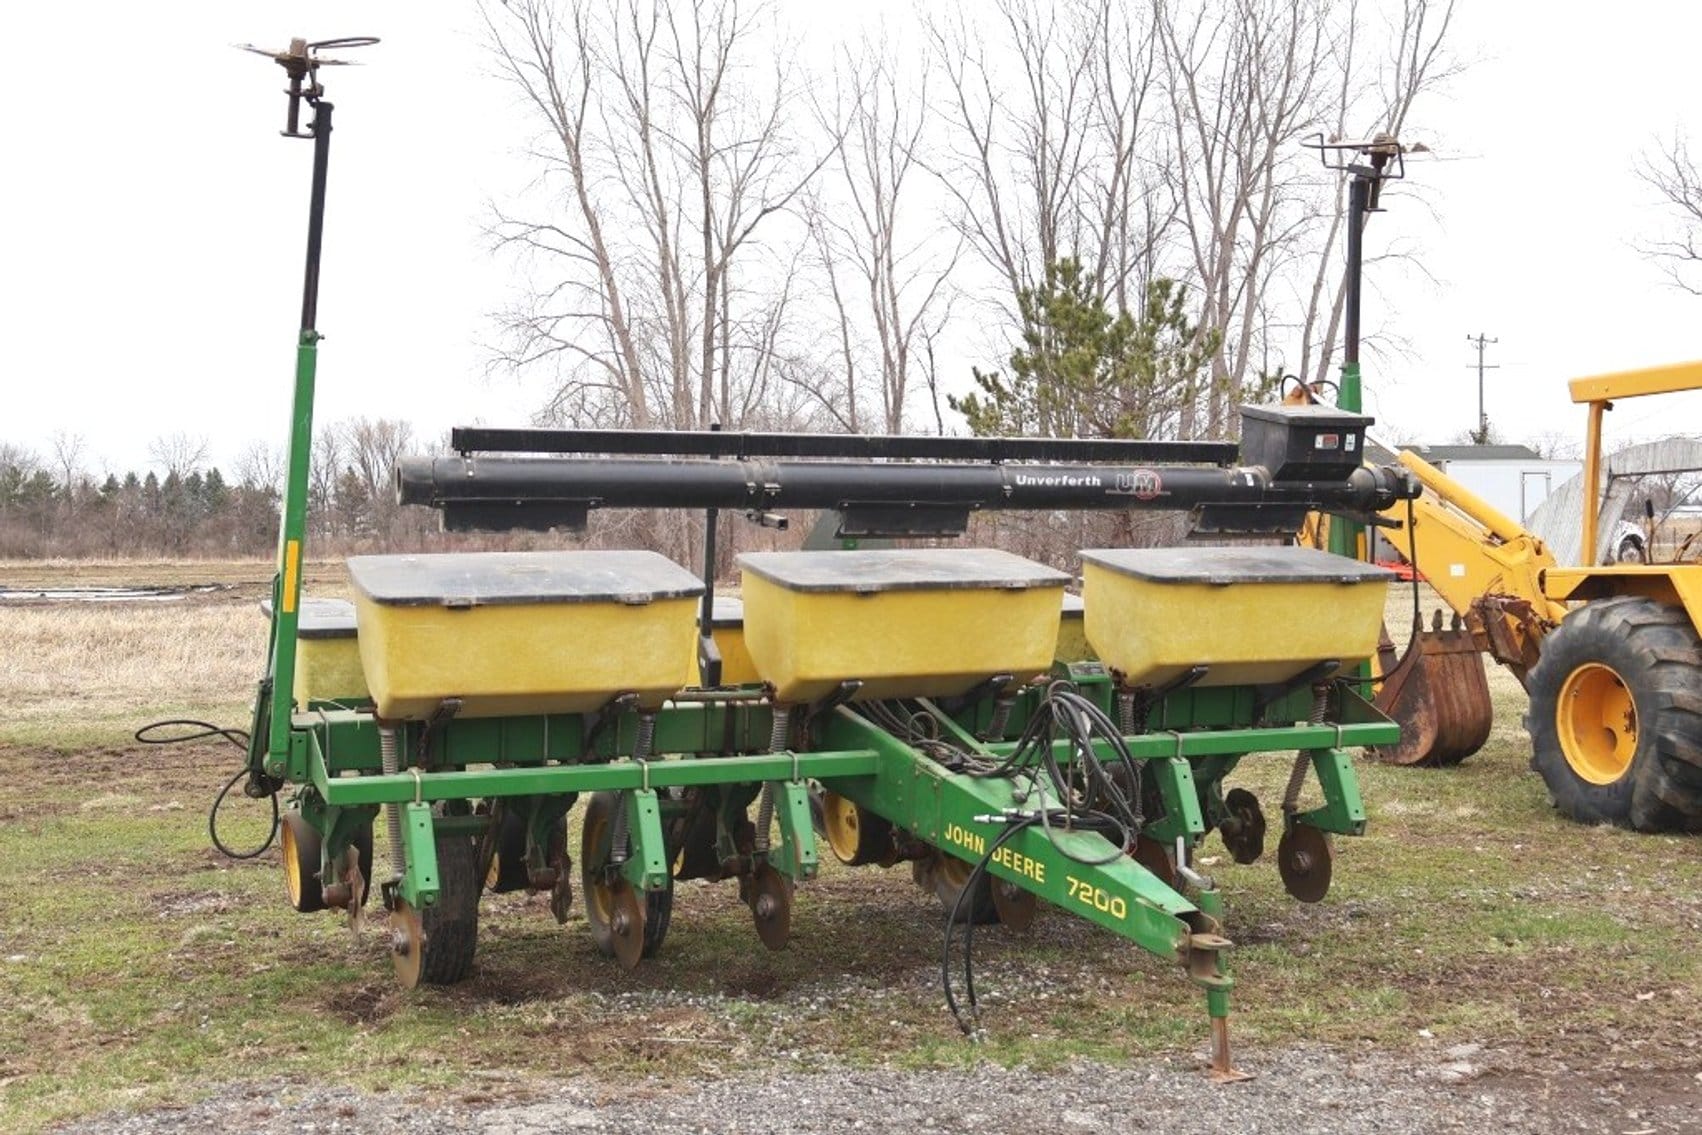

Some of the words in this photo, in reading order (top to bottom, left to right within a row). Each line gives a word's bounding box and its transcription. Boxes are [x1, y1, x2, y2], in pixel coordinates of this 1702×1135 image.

[1016, 475, 1101, 486] Unverferth
[944, 823, 985, 855] JOHN
[992, 847, 1045, 883] DEERE
[1066, 875, 1126, 919] 7200
